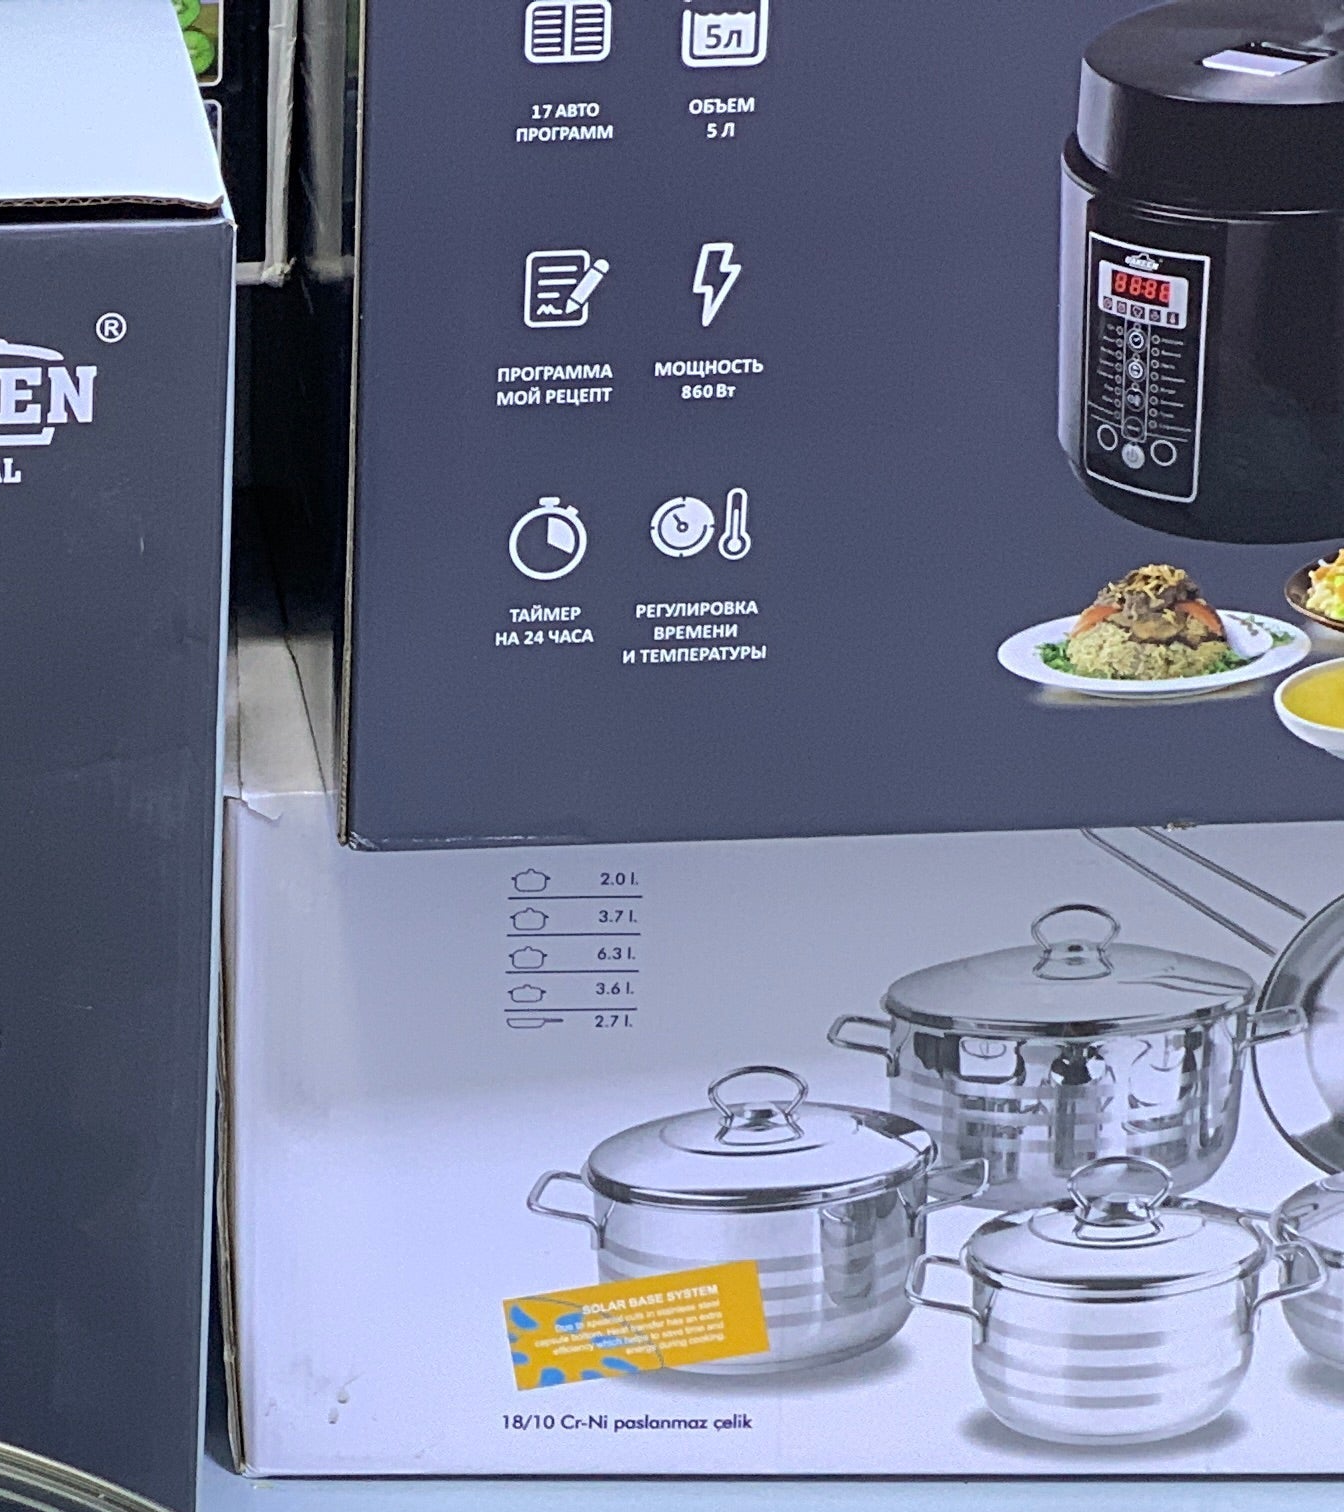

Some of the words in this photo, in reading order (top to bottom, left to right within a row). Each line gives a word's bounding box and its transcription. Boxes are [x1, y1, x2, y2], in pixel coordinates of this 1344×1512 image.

[705, 24, 743, 49] 5л
[531, 104, 553, 120] 17
[555, 102, 600, 119] АВТО
[688, 97, 756, 115] ОБЪЕМ
[516, 125, 614, 143] ПРОГРАММ
[706, 122, 718, 139] 5
[721, 121, 735, 138] Л
[497, 364, 613, 383] ПРОГРАММА
[654, 358, 764, 378] МОЩНОСТЬ
[496, 386, 541, 407] МОЙ
[545, 387, 613, 407] РЕЦЕПТ
[681, 384, 713, 400] 860
[716, 383, 736, 398] Вт
[509, 605, 582, 623] ТАЙМЕР
[635, 600, 759, 619] РЕГУЛИРОВКА
[495, 631, 520, 647] НА
[524, 630, 544, 645] 24
[547, 628, 594, 644] ЧАСА
[654, 623, 738, 641] ВРЕМЕНИ
[622, 649, 636, 664] И
[640, 645, 767, 664] ТЕМПЕРАТУРЫ
[600, 872, 626, 886] 2.0
[598, 909, 625, 923] 3.7
[597, 947, 622, 960] 6.3
[595, 982, 620, 996] 3.6
[594, 1015, 619, 1028] 2.7
[582, 1299, 626, 1315] SOLAR
[629, 1294, 663, 1308] BASE
[667, 1285, 718, 1301] SYSTEM
[502, 1414, 555, 1431] 18/10
[560, 1414, 608, 1430] Cr-Ni
[613, 1414, 708, 1432] paslanmaz
[713, 1413, 753, 1432] çelik
